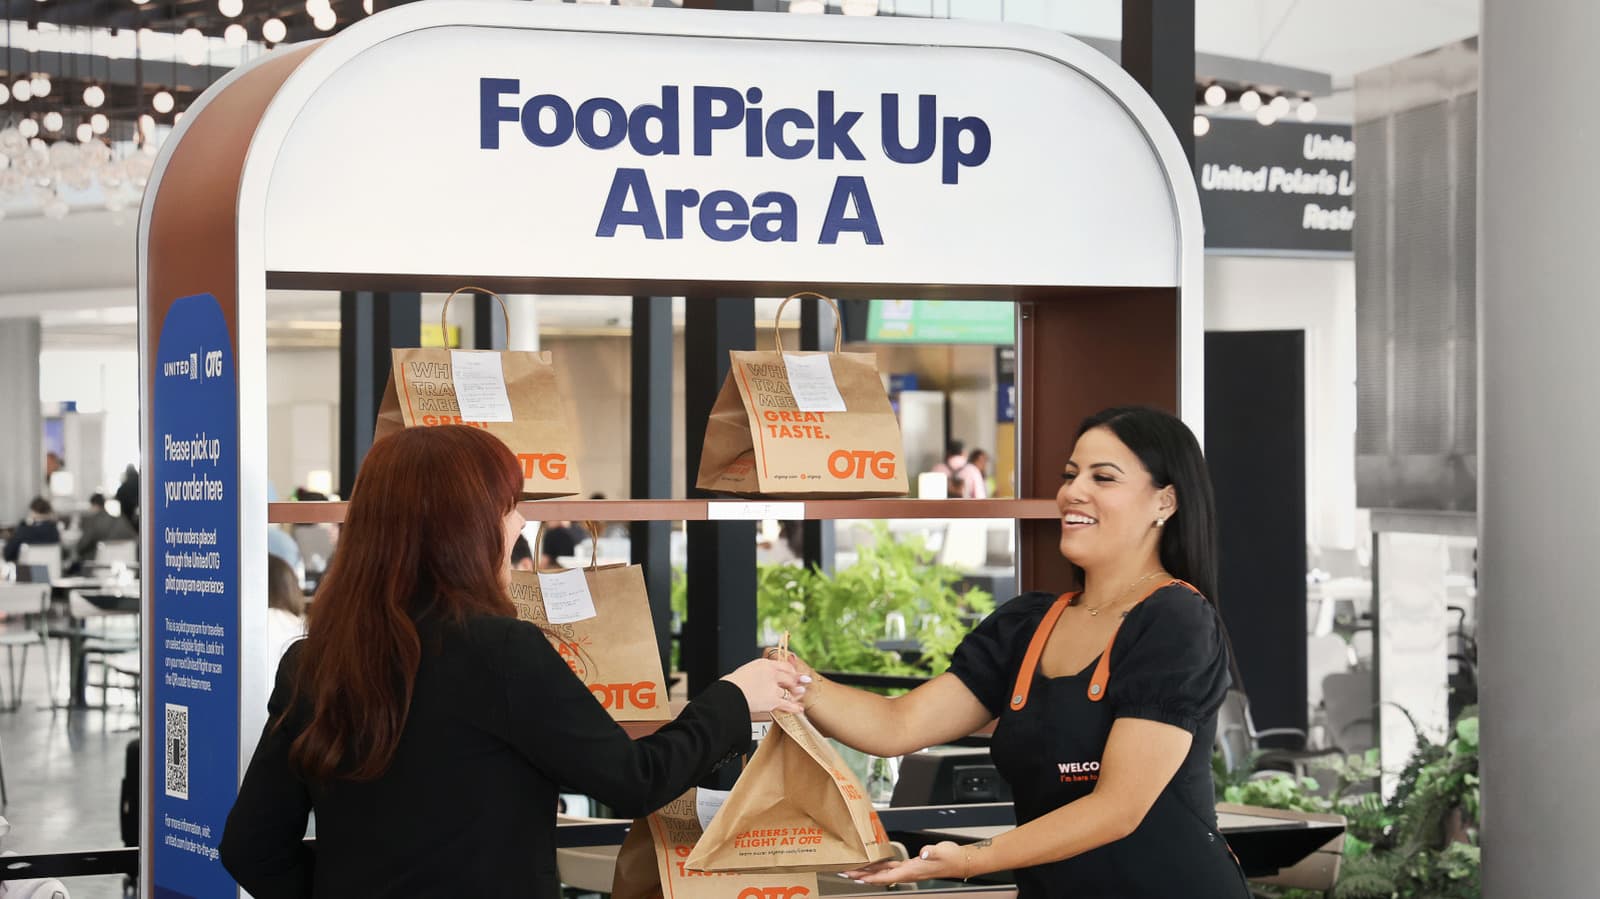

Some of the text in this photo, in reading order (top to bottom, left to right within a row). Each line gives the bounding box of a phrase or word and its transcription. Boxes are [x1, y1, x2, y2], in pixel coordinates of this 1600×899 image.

[480, 77, 992, 184] Food Pick Up
[1201, 163, 1268, 192] United
[1268, 166, 1337, 196] Polaris
[595, 167, 884, 245] Area A
[164, 350, 223, 377] UNITED OTG
[763, 410, 825, 423] GREAT
[767, 424, 831, 439] TASTE.
[164, 431, 220, 467] Please pick up
[517, 453, 567, 480] TG
[827, 449, 896, 480] OTG
[164, 472, 223, 508] your order here
[165, 527, 175, 548] Only
[183, 528, 199, 545] orders
[199, 528, 217, 549] placed
[165, 550, 220, 572] through the United OTG
[165, 574, 224, 597] pilot program experience
[588, 681, 656, 710] OTG
[1058, 761, 1100, 773] WELCO
[734, 835, 823, 848] FLIGHT AT OTG
[736, 827, 824, 840] CAREERS TAKE
